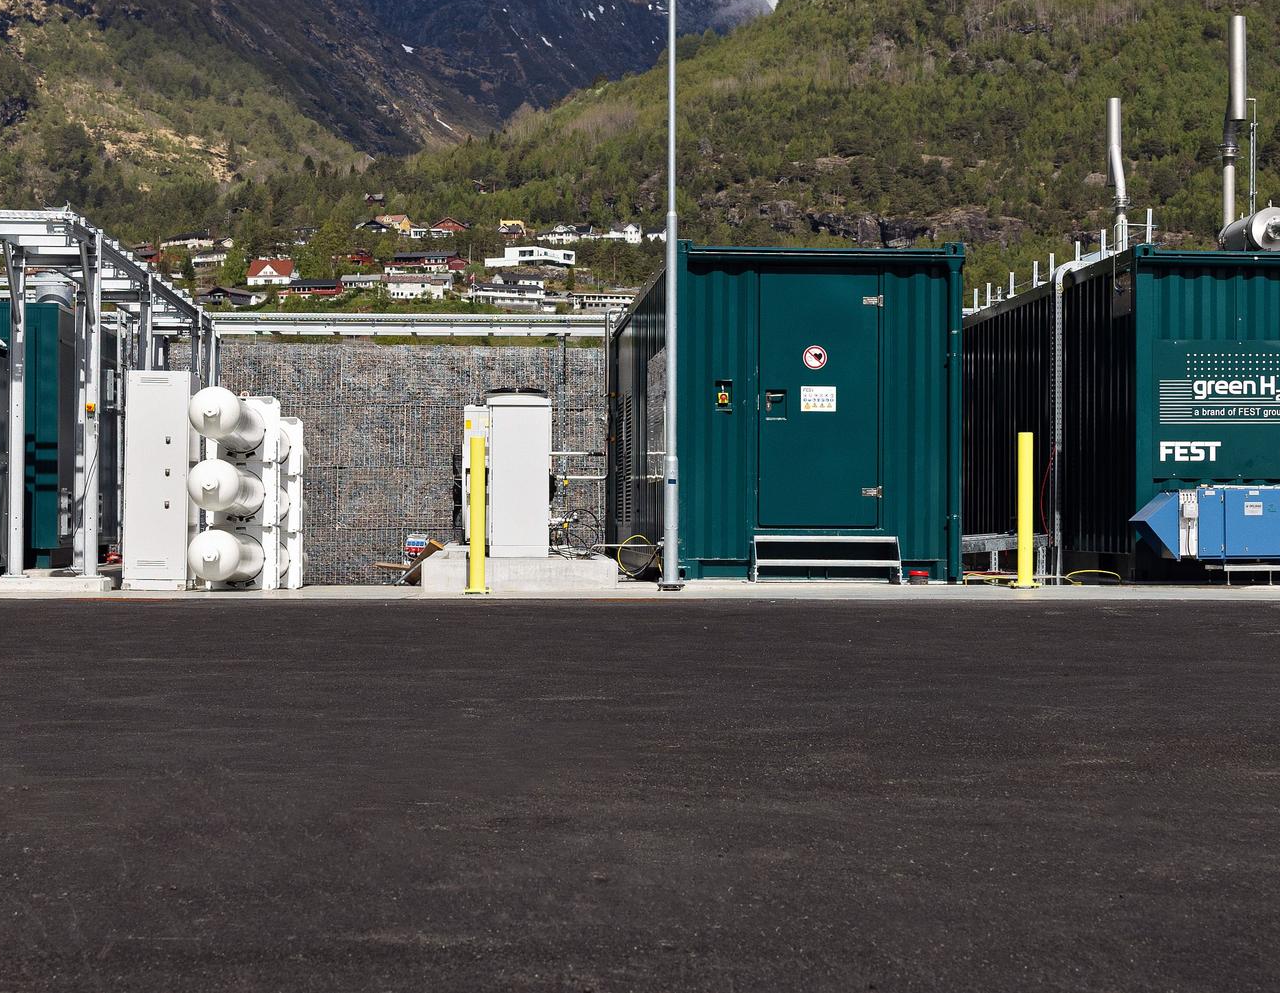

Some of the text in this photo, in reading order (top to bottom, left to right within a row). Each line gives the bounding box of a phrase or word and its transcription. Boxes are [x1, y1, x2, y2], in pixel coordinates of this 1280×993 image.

[1193, 380, 1257, 399] green
[1202, 408, 1225, 416] brand
[1228, 408, 1237, 416] of
[1239, 408, 1261, 416] FEST
[1160, 441, 1221, 461] FEST
